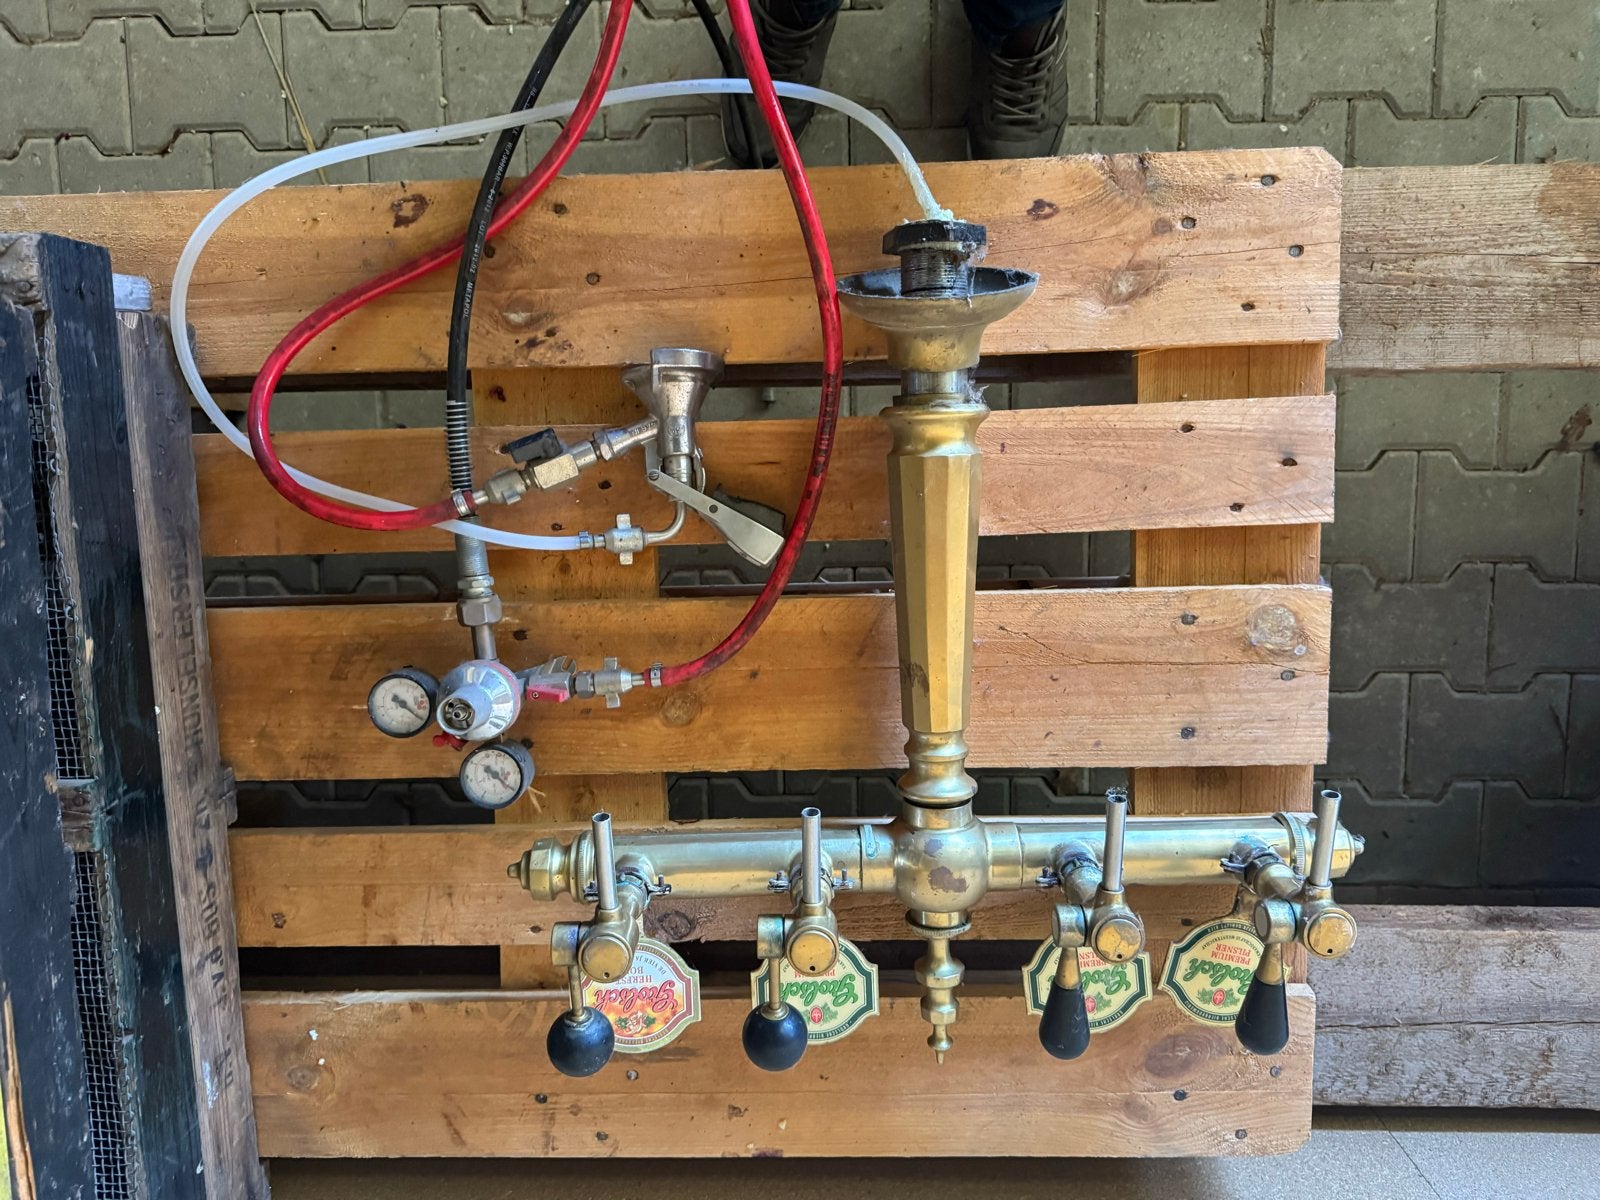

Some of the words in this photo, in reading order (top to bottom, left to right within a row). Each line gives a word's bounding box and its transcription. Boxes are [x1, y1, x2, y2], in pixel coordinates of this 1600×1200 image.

[1210, 951, 1251, 965] PREMIUM
[1215, 944, 1251, 957] PILSNER
[593, 979, 678, 1013] Grolsch
[779, 974, 858, 1007] Grolsch
